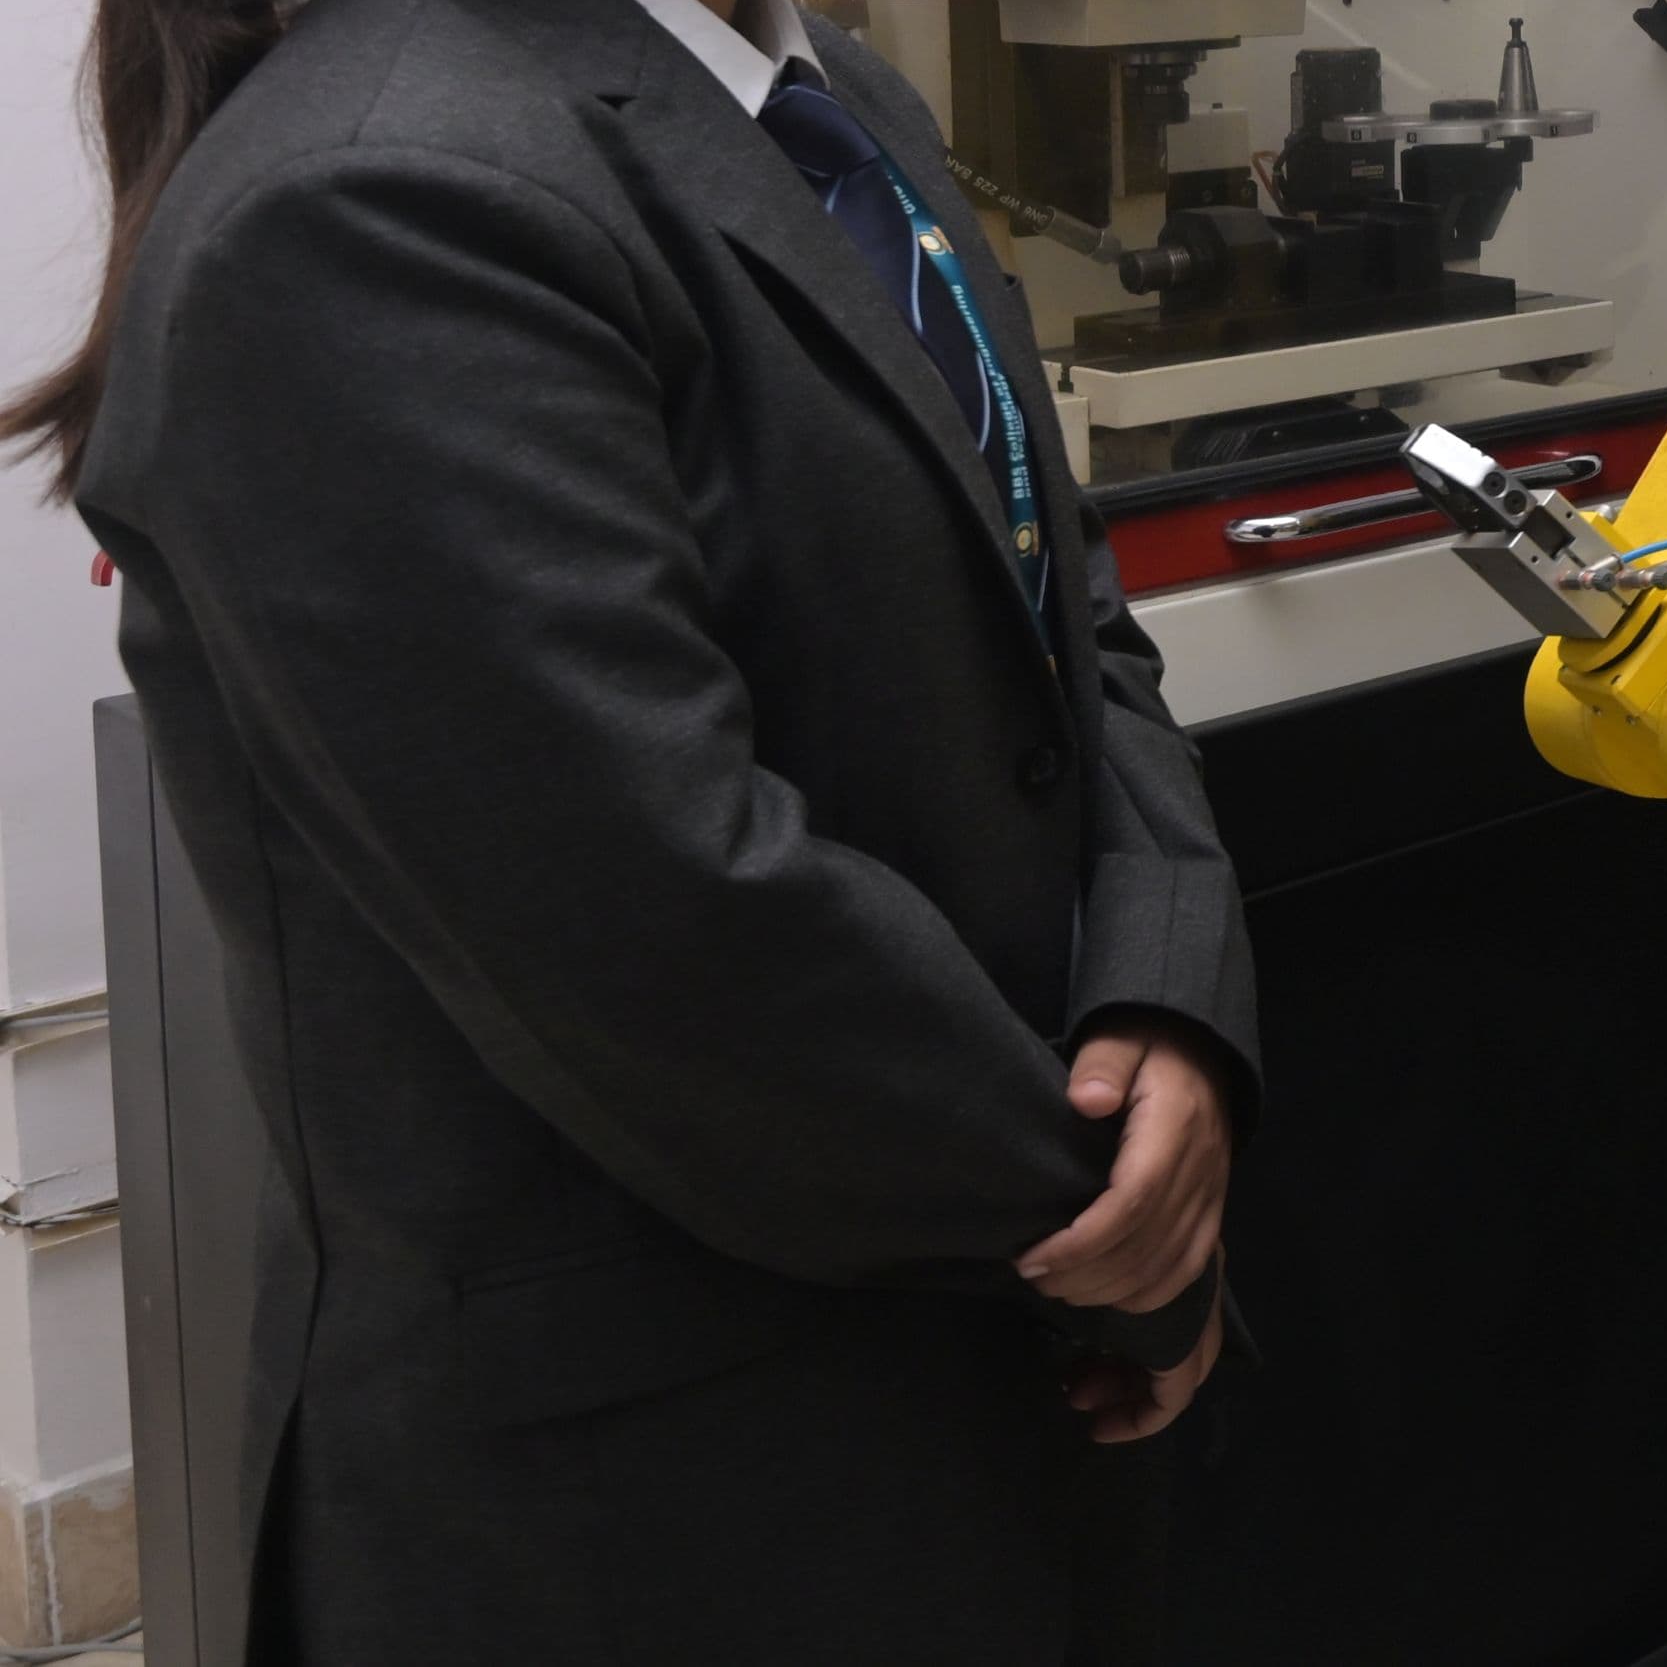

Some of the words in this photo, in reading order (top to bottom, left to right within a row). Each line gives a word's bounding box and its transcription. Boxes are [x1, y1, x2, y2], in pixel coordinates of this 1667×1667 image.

[945, 154, 972, 180] BAR
[974, 176, 999, 196] 225
[950, 284, 998, 377] Engineering
